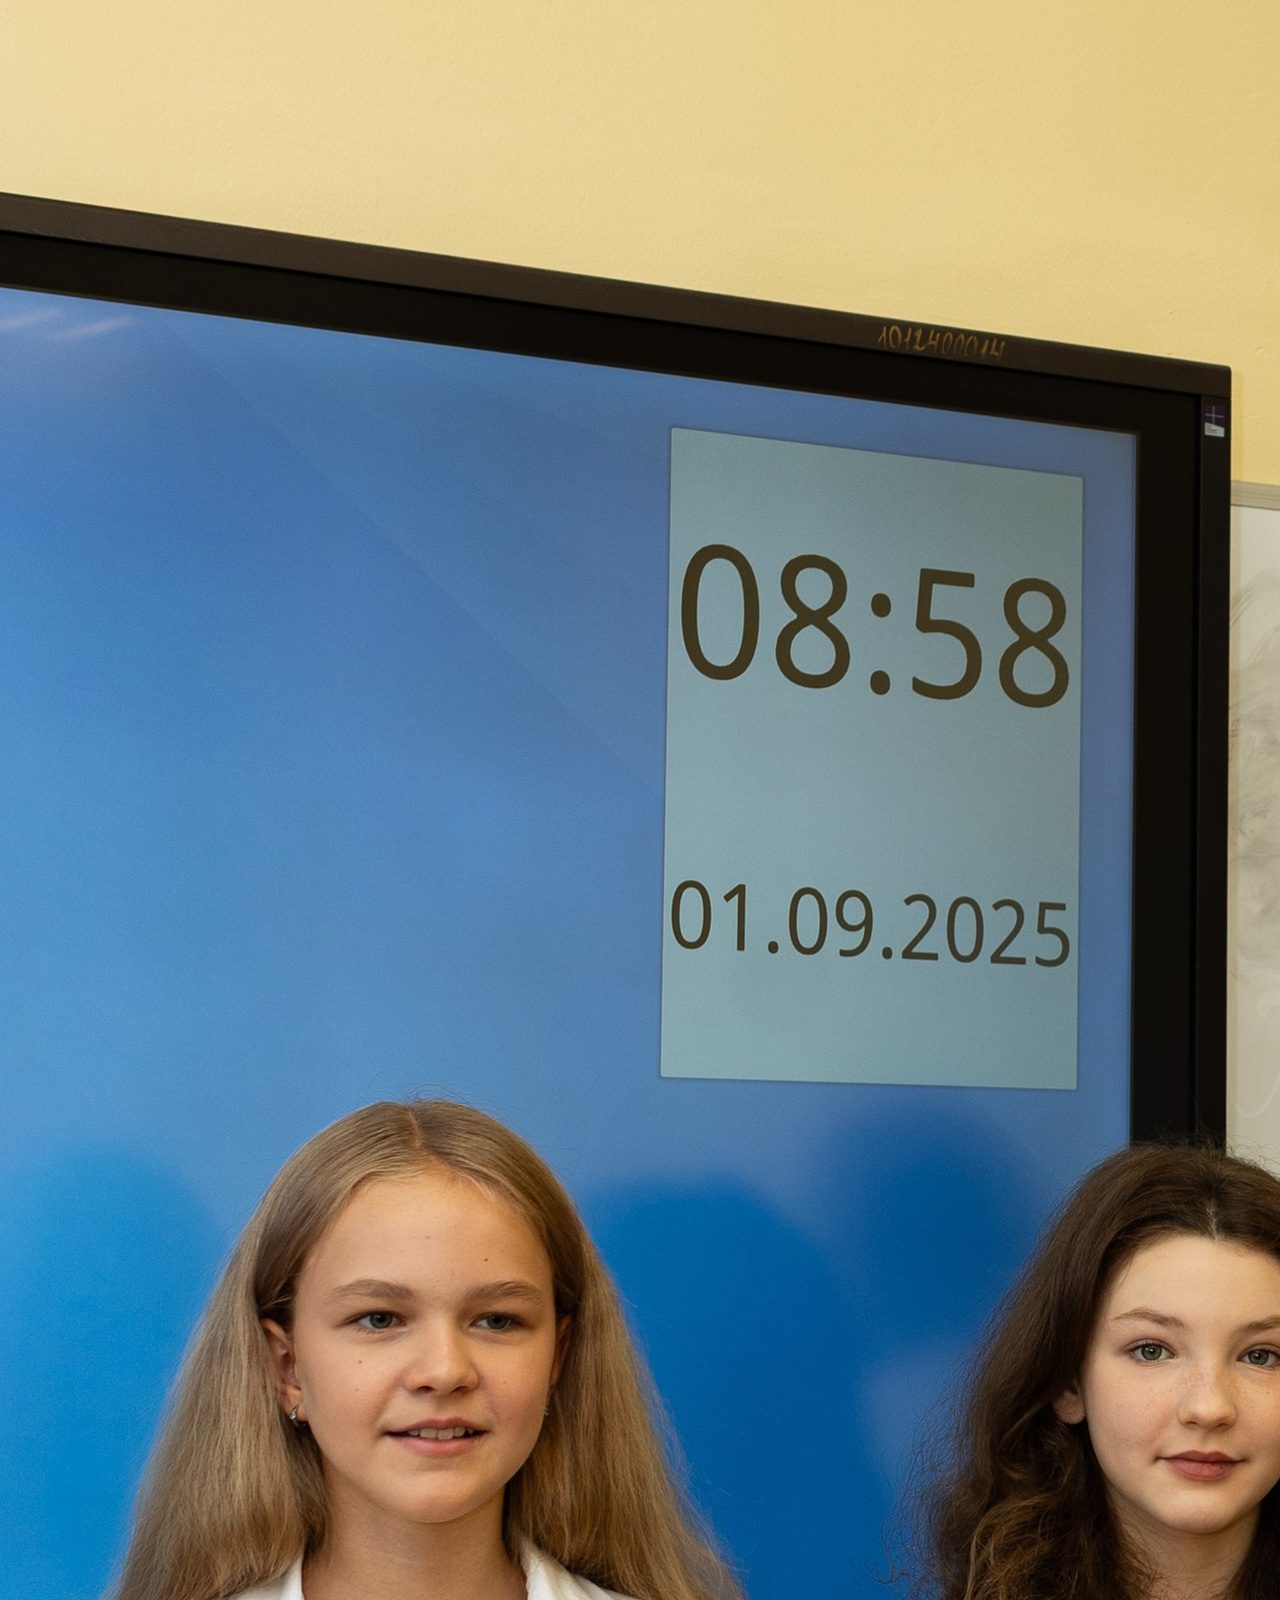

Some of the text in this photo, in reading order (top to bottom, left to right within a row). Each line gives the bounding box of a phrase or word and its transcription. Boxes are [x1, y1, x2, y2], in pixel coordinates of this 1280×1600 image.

[878, 325, 1006, 360] 1012400014
[681, 544, 1069, 708] 08:58
[671, 880, 1070, 967] 01.09.2025
